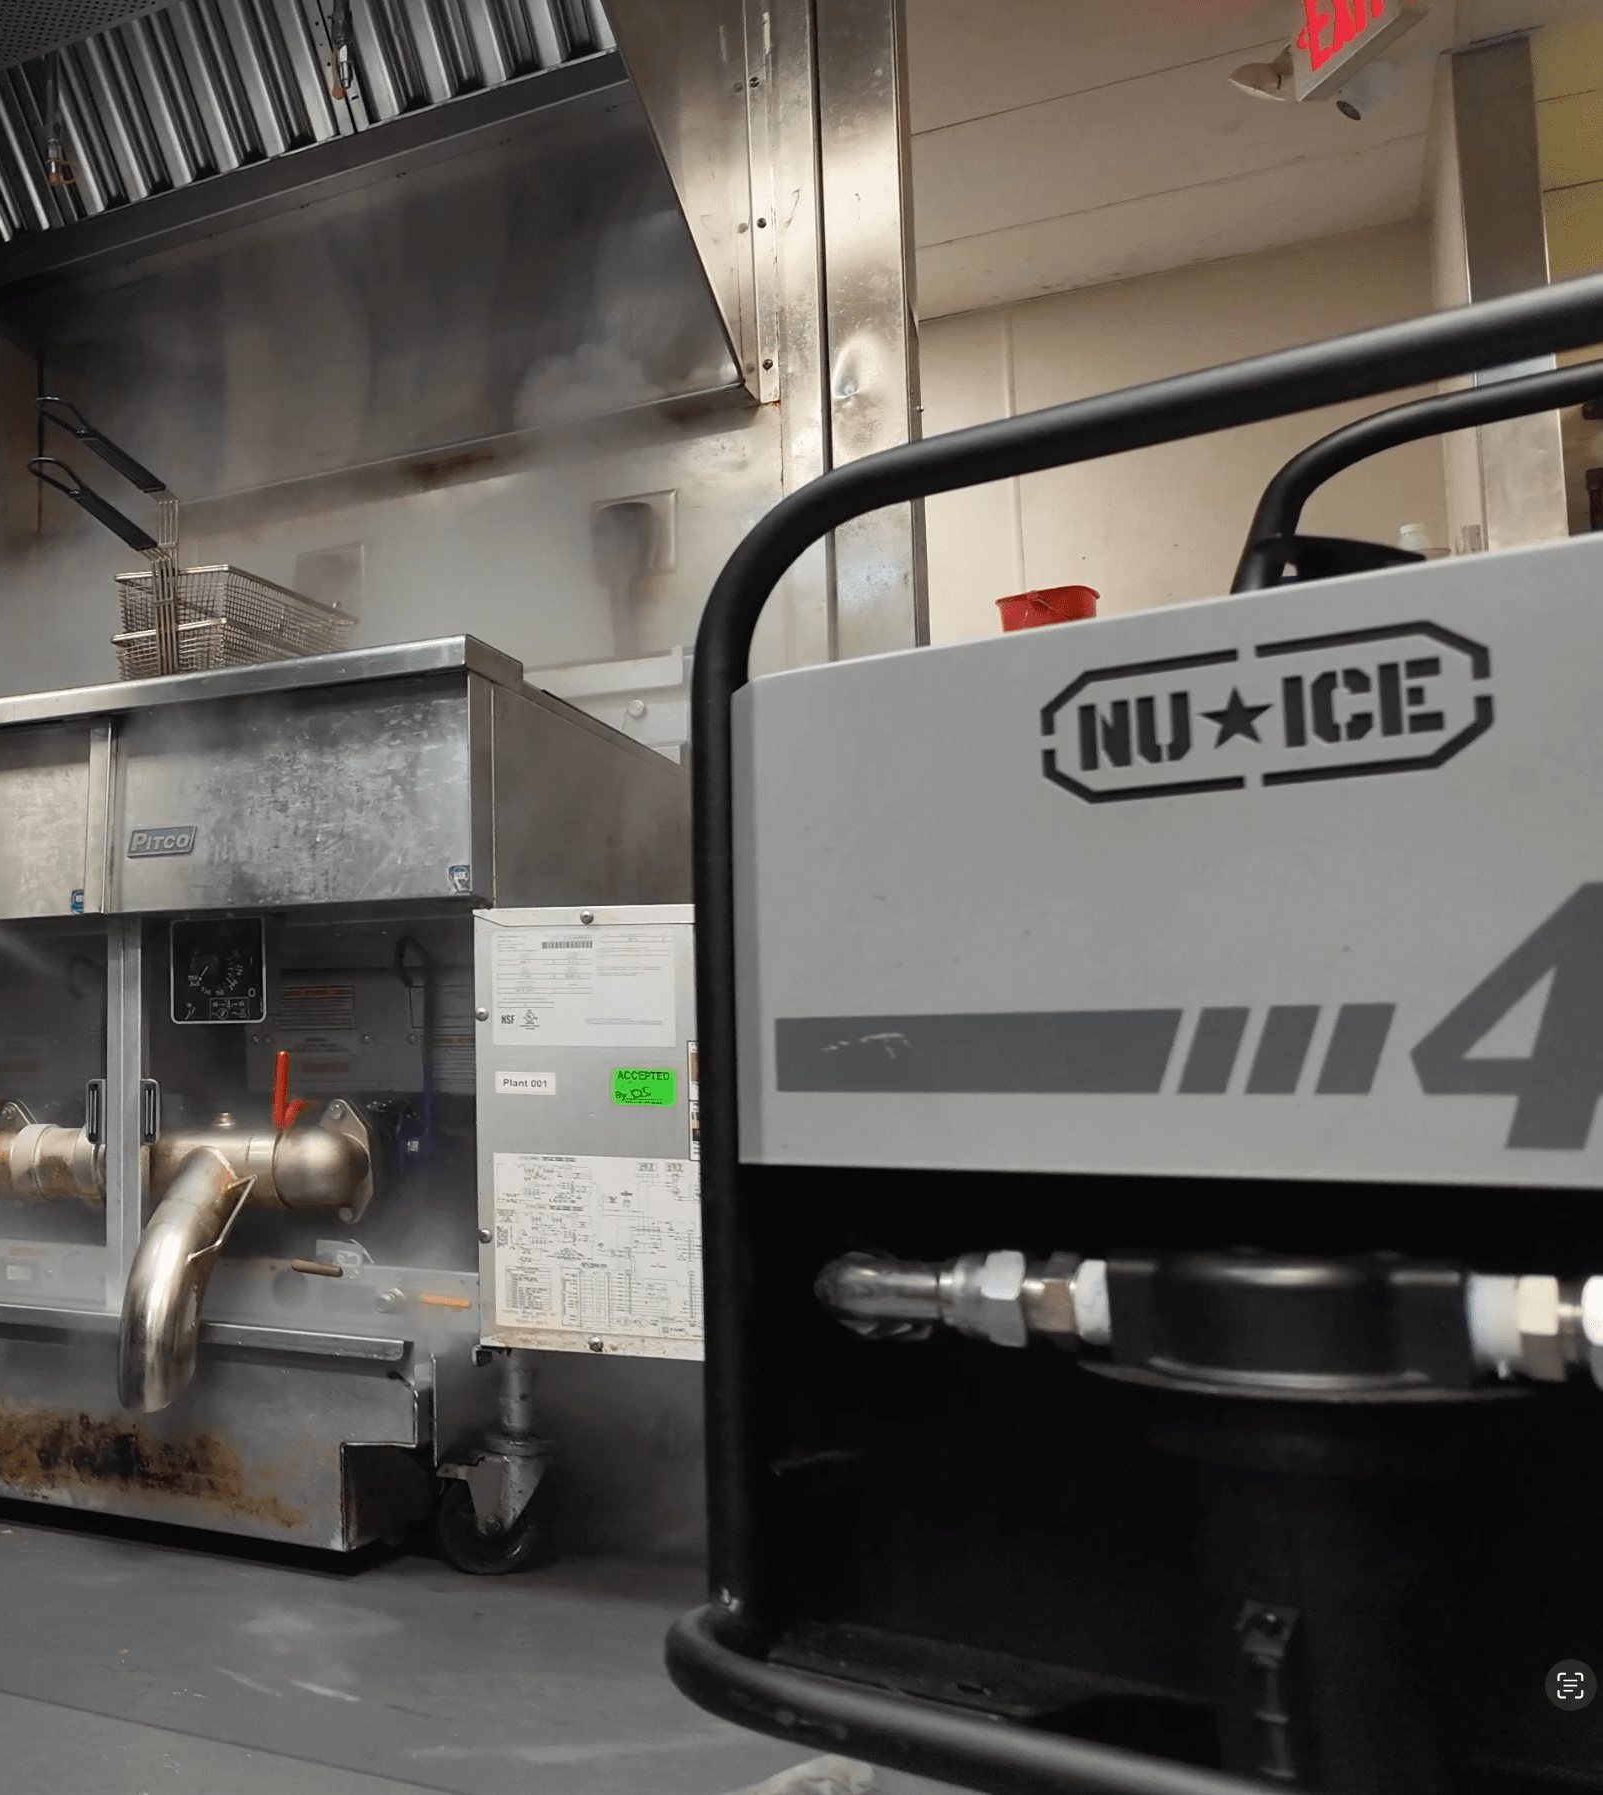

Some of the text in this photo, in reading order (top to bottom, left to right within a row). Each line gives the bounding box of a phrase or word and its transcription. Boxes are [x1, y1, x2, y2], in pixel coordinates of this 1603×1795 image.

[1078, 656, 1446, 772] NU ICE
[500, 1014, 516, 1025] NSF
[617, 1070, 671, 1081] ACCEPTED
[502, 1078, 548, 1089] Plant 001
[614, 1090, 628, 1102] By
